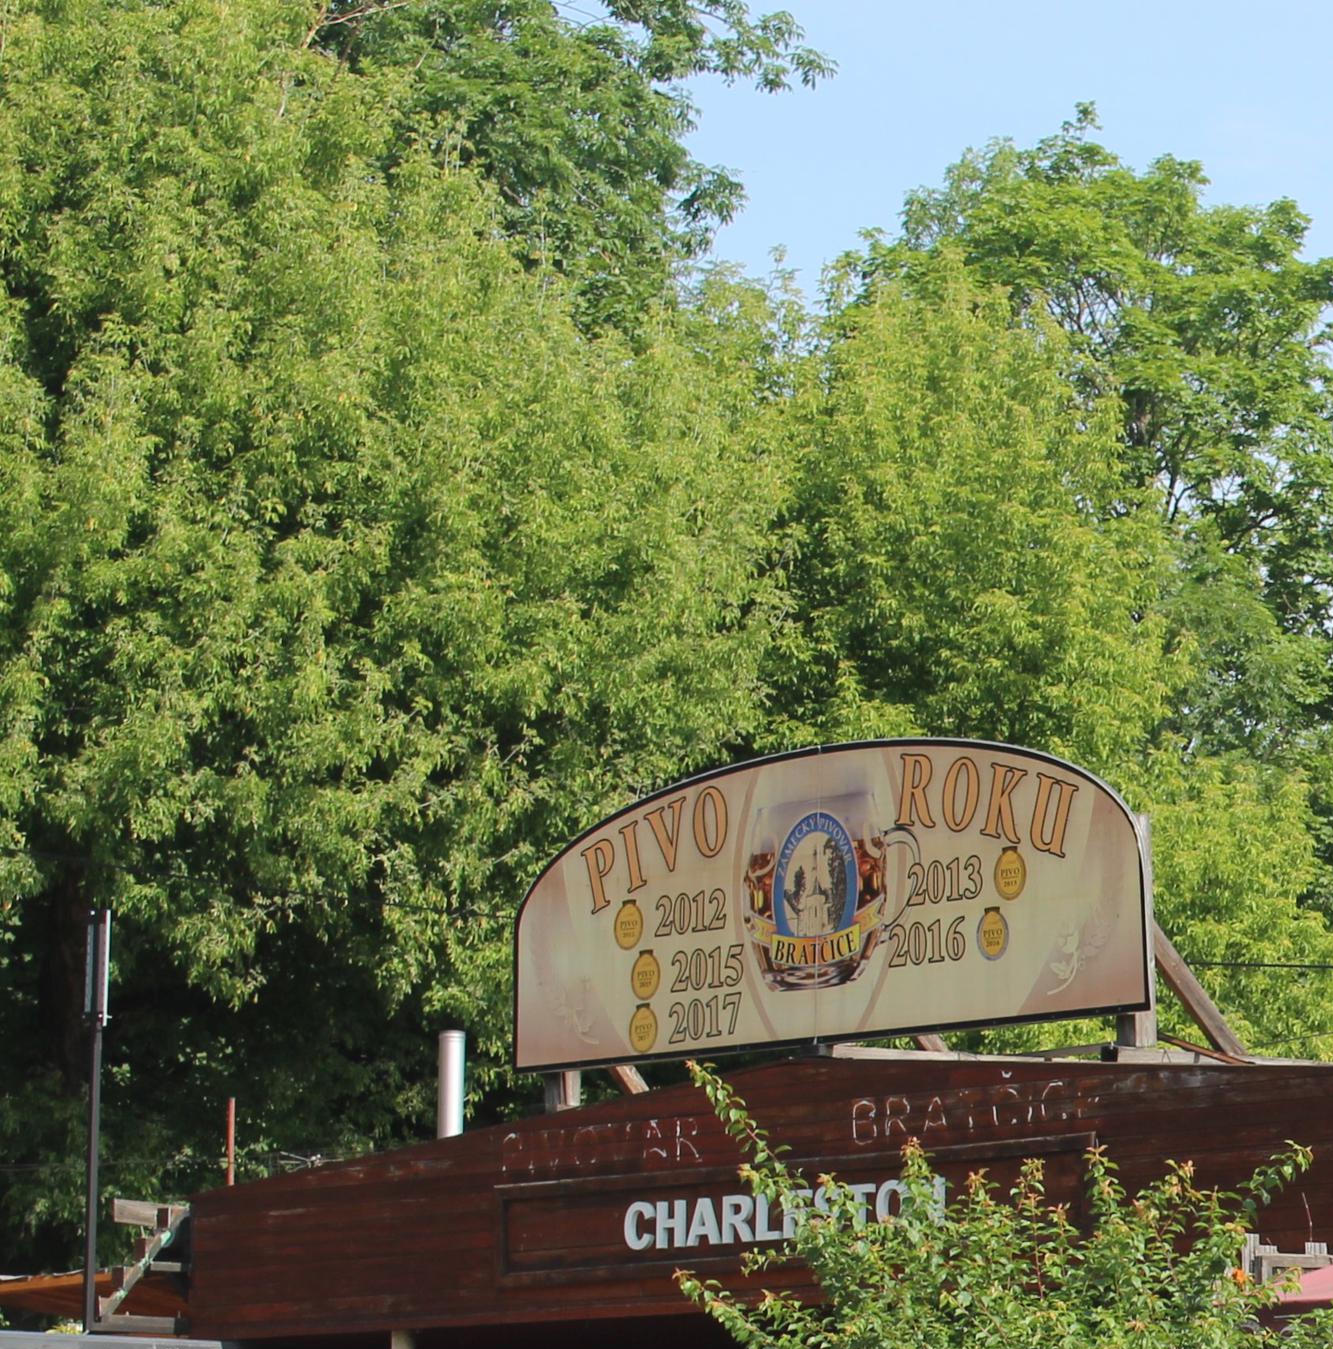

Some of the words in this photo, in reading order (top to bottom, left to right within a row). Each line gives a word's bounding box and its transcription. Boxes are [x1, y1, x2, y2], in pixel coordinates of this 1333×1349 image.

[581, 785, 728, 915] PIVO
[895, 752, 1080, 859] ROKU
[907, 854, 983, 907] 2013
[654, 887, 726, 938] 2012
[671, 943, 744, 993] 2015
[773, 929, 857, 966] BRATČICE
[888, 915, 966, 968] 2016
[668, 991, 742, 1045] 2017
